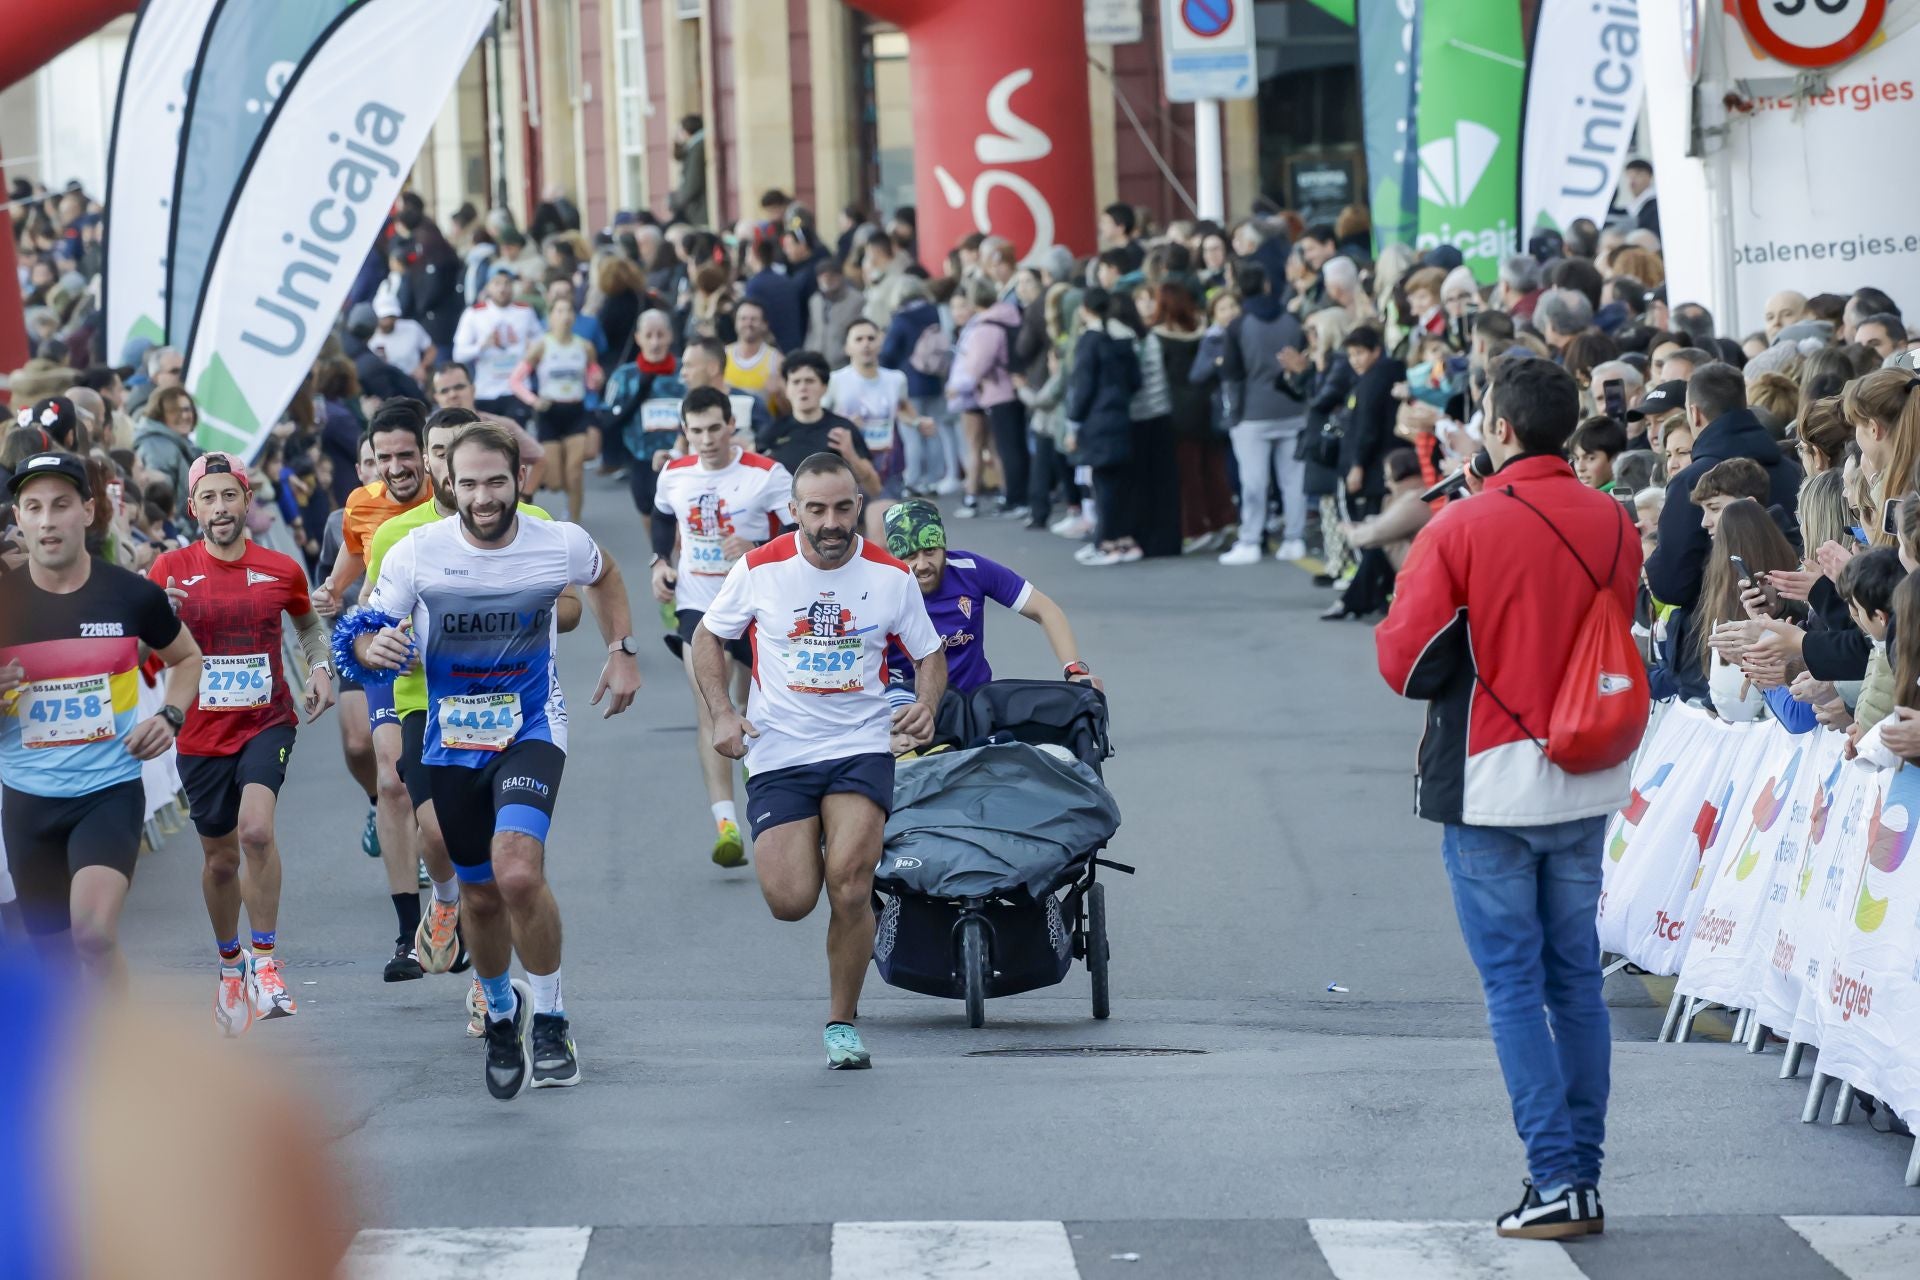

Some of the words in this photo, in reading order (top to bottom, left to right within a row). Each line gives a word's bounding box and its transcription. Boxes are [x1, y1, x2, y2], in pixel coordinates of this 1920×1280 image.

[1560, 0, 1639, 198] Unicaj
[239, 101, 406, 358] Unicaja
[1735, 233, 1920, 266] otalenergies.e
[813, 610, 839, 625] SAN
[823, 604, 840, 615] 55
[80, 622, 124, 637] 226ERS
[813, 623, 838, 637] SIL
[813, 638, 827, 646] SAN
[796, 650, 856, 672] 2529
[45, 684, 61, 692] SAN
[62, 678, 104, 691] SILVESTRE
[207, 670, 264, 690] 2796
[476, 694, 515, 705] SILVEST
[29, 695, 102, 723] 4758
[447, 707, 514, 730] 4424
